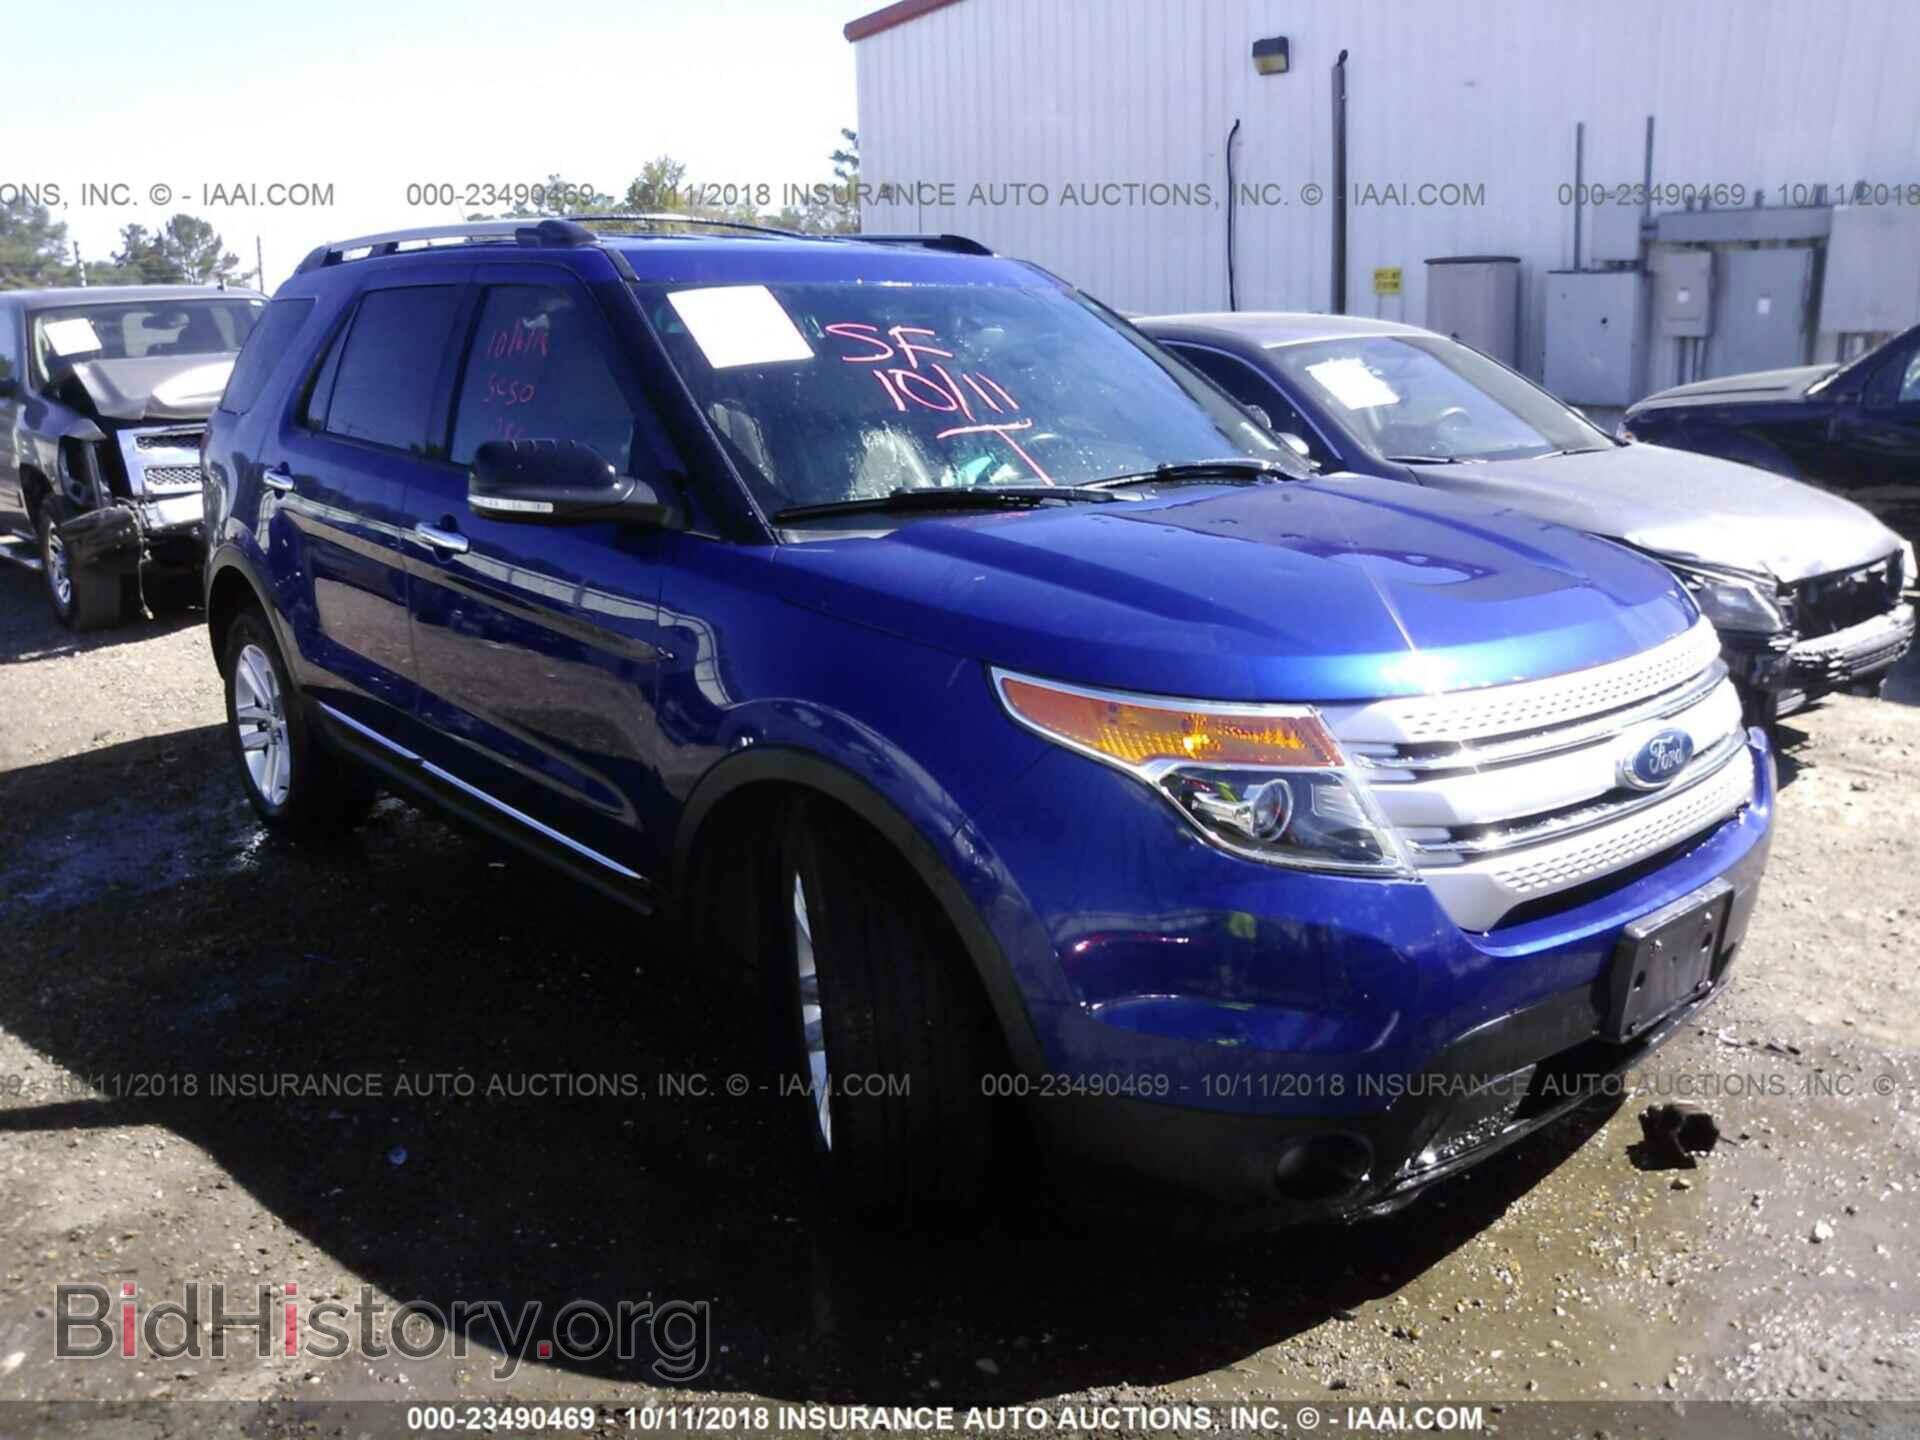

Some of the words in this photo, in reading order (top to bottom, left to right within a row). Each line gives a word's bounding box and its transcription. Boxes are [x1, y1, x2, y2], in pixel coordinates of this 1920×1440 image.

[825, 323, 953, 369] SF
[872, 363, 1021, 422] 10/11
[1648, 735, 1685, 774] Ford
